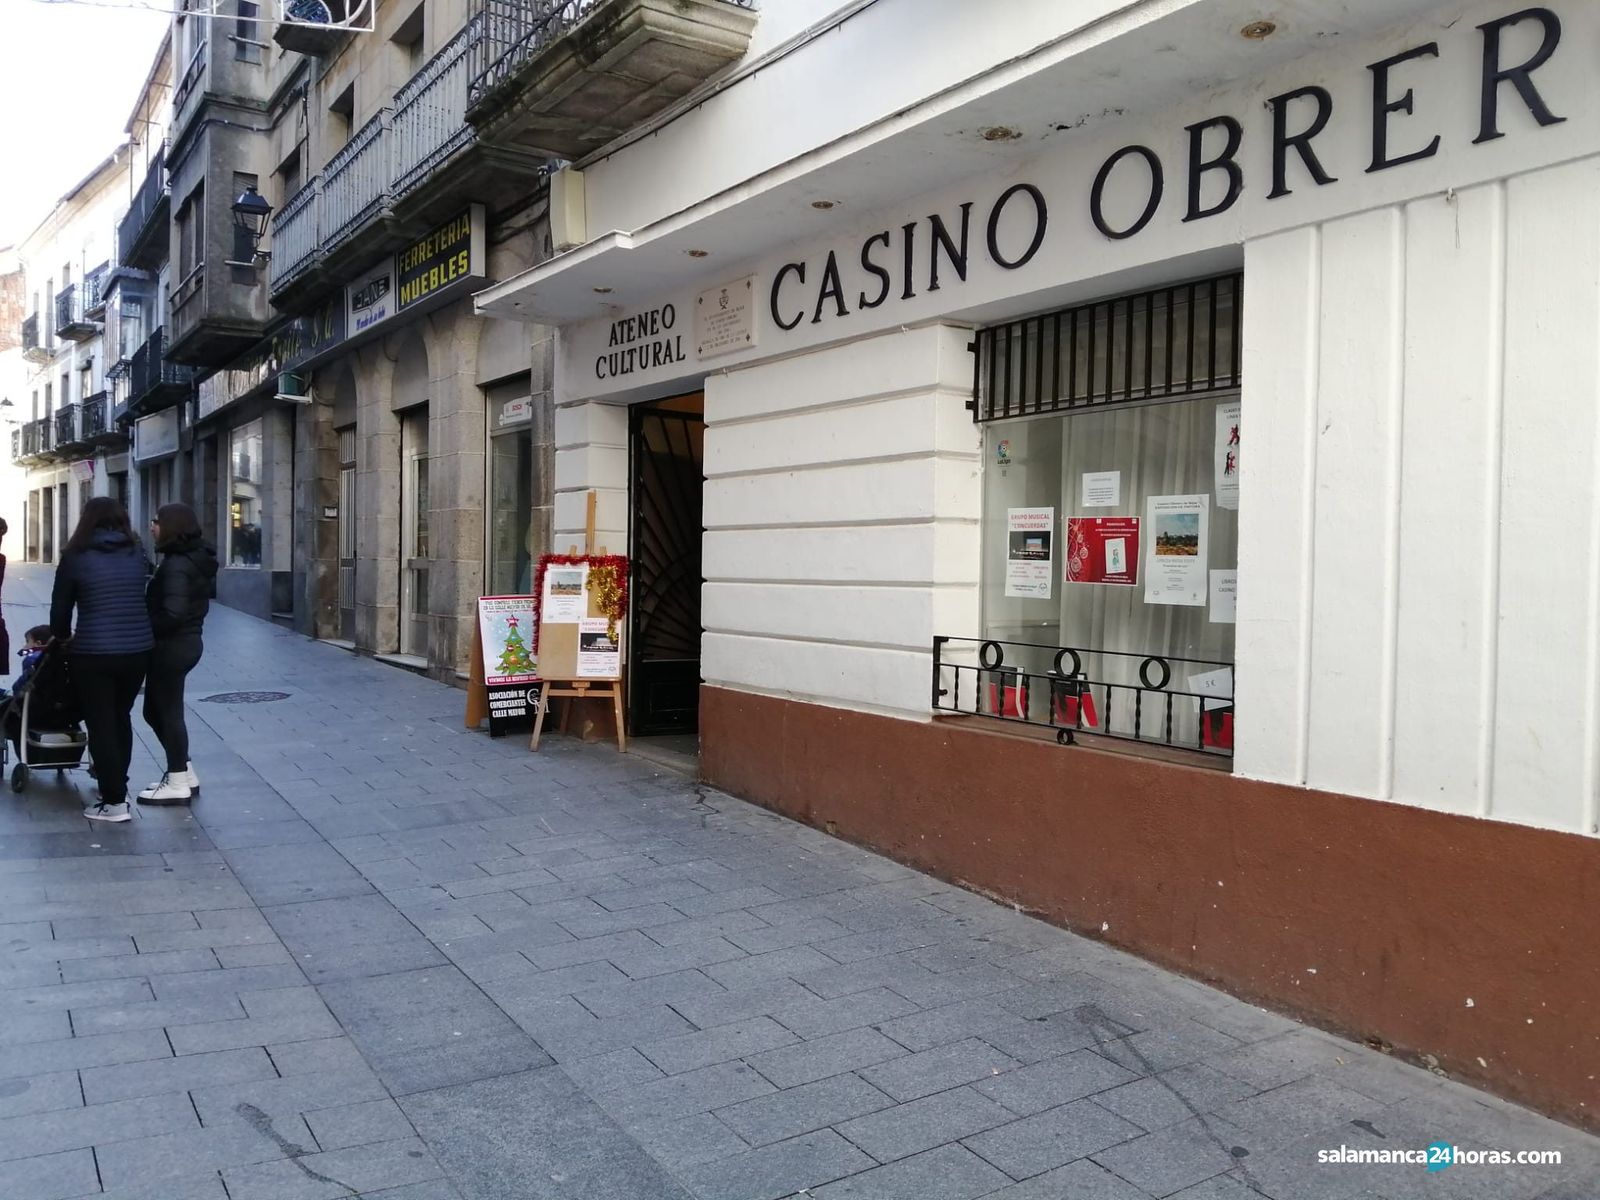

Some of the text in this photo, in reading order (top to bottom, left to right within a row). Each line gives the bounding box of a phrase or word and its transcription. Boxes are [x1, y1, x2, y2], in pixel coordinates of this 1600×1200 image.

[769, 6, 1568, 332] CASINO OBRER
[399, 213, 470, 275] FERRETERIA
[400, 250, 469, 306] MUEBLES
[608, 303, 676, 348] ATENEO
[595, 335, 686, 379] CULTURAL
[489, 699, 527, 709] COMERCIANTES
[492, 708, 526, 718] CALLE MAYOR
[518, 690, 526, 698] DE
